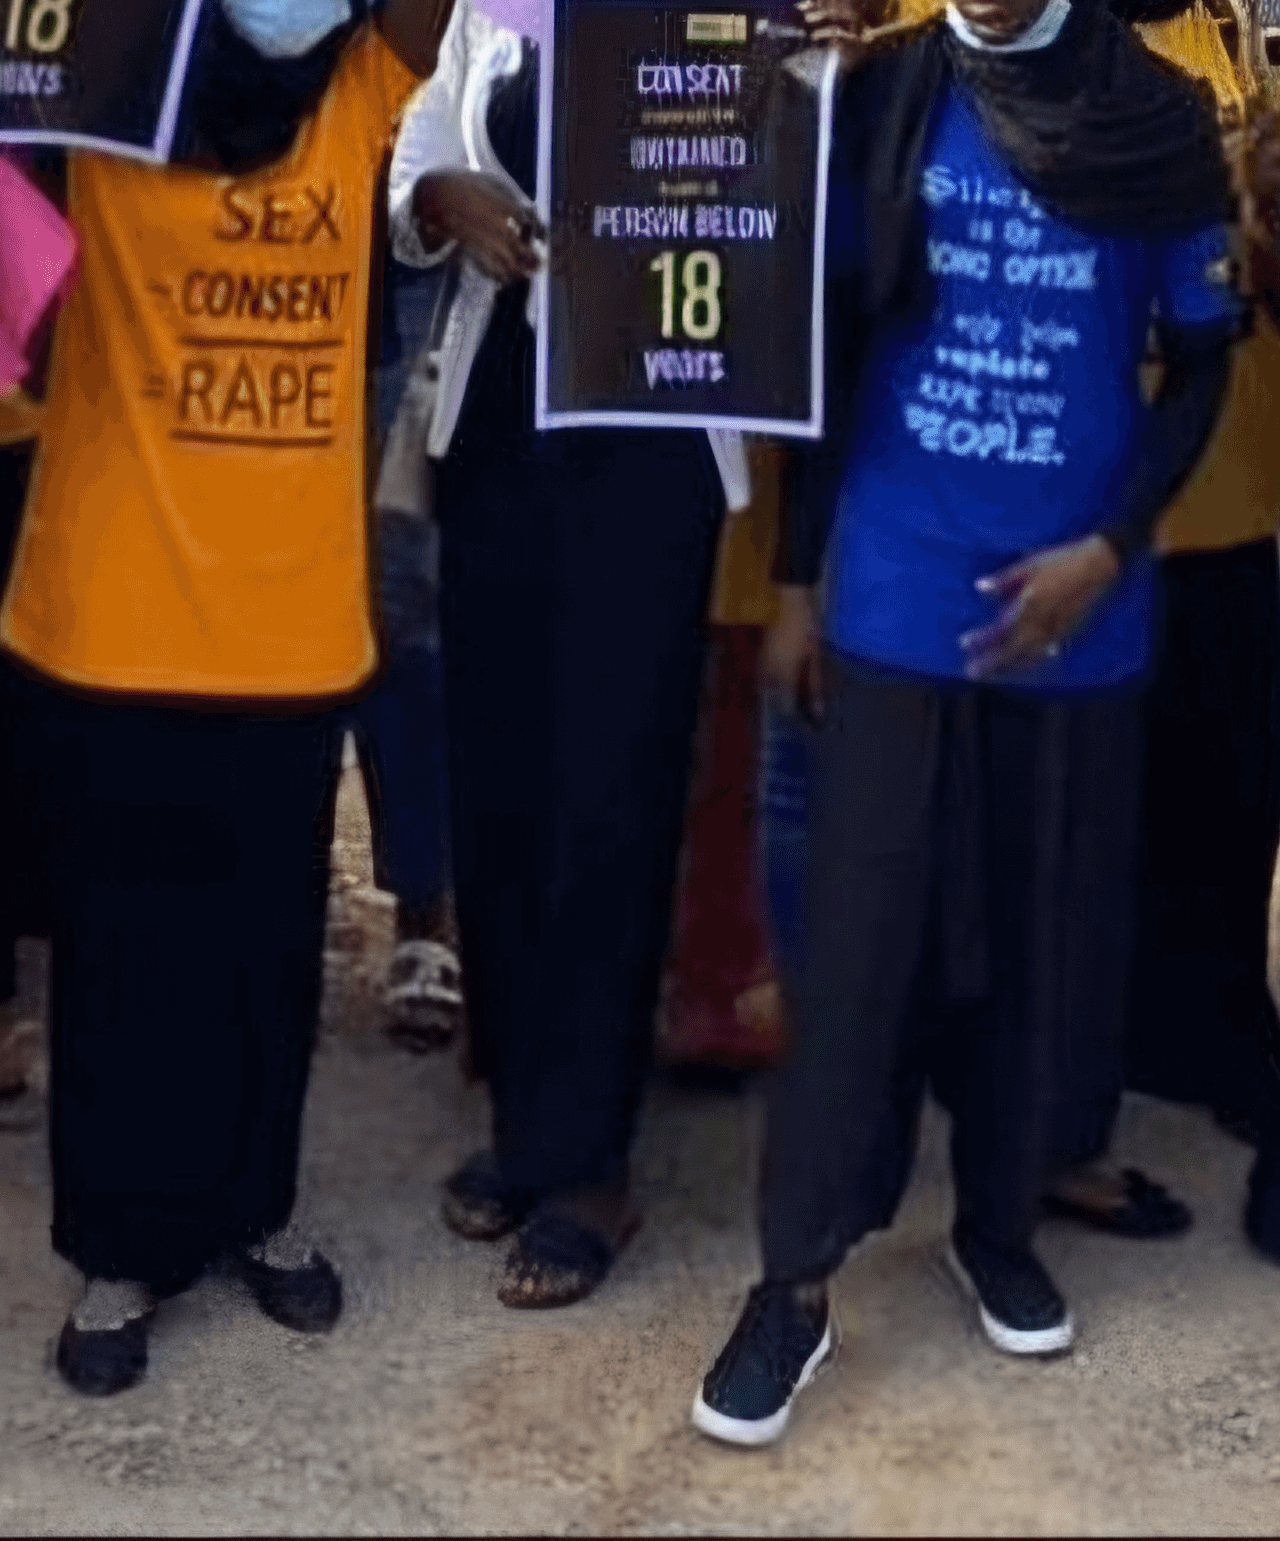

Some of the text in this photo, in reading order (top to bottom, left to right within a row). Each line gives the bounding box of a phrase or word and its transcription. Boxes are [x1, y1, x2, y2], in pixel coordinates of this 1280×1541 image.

[213, 179, 342, 244] SEX
[182, 268, 352, 324] CONSENT
[650, 251, 722, 340] 18
[178, 354, 336, 429] RAPE
